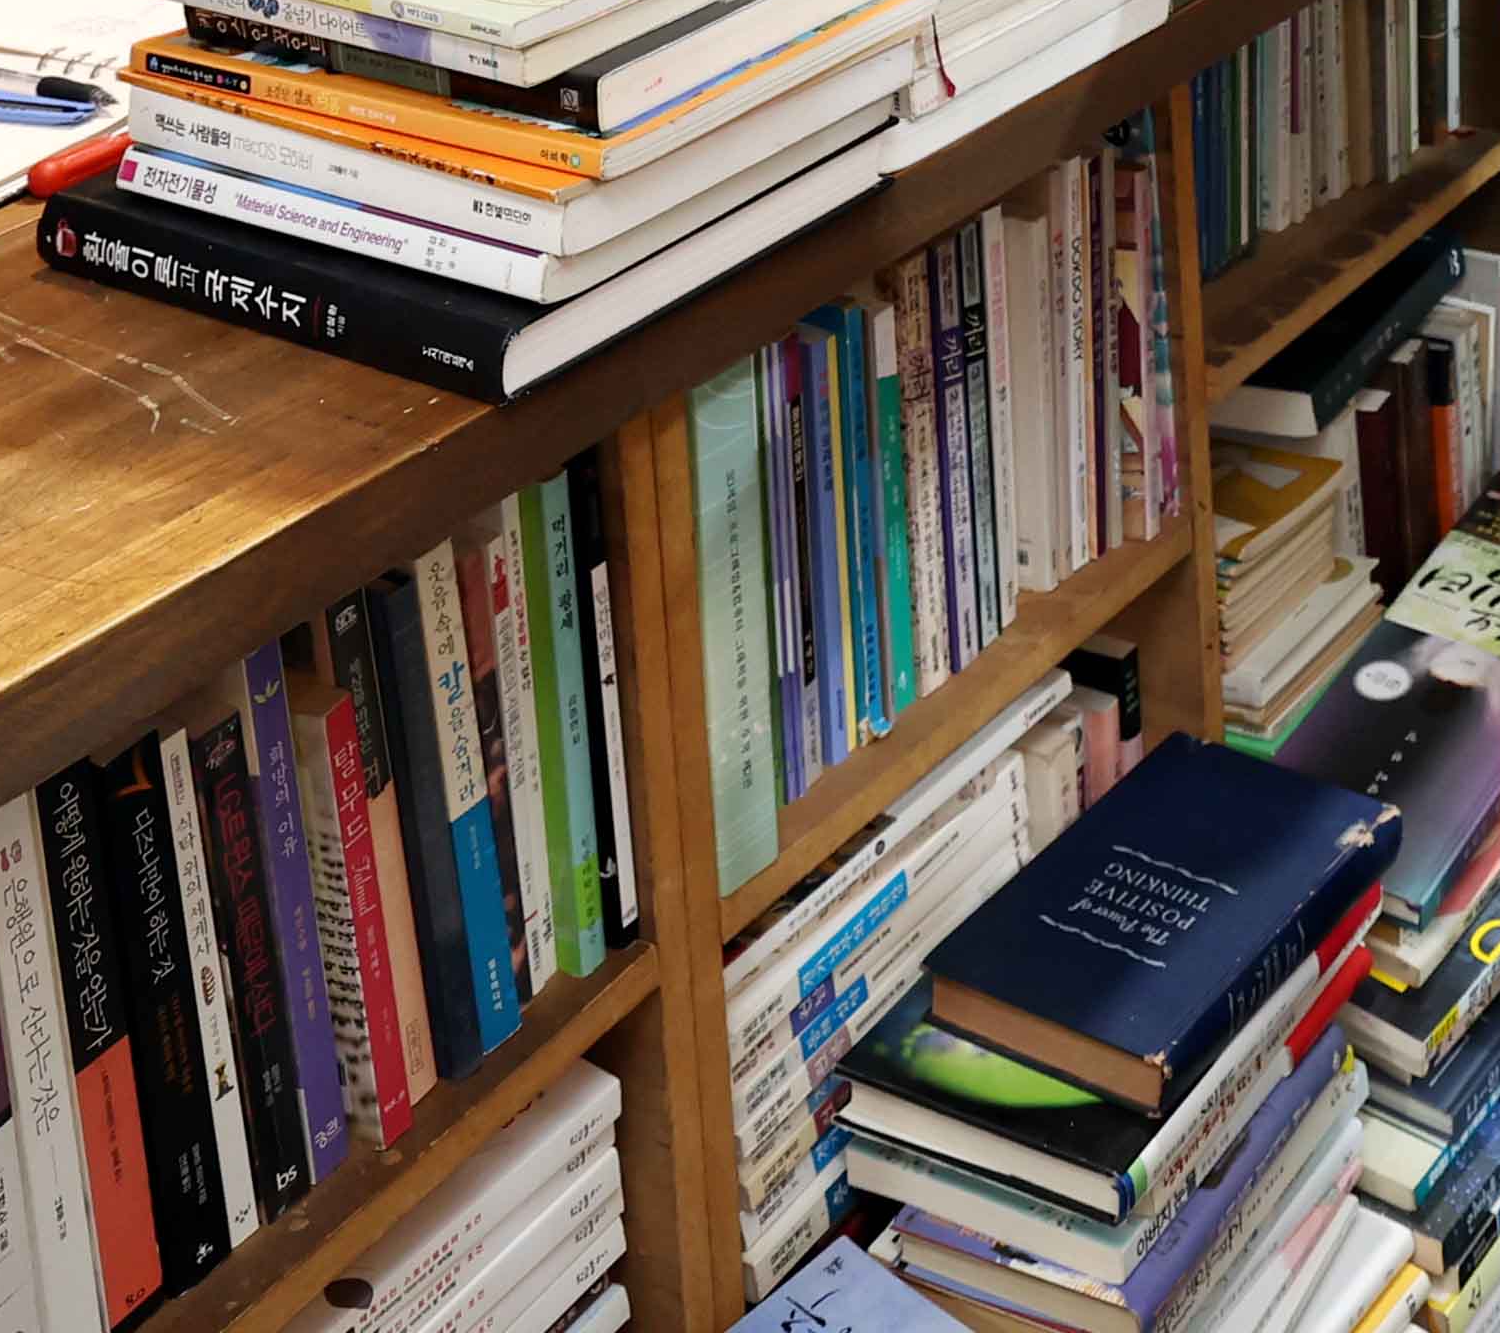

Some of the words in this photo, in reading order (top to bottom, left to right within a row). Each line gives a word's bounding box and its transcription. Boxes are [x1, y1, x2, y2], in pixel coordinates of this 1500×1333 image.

[142, 166, 218, 206] 전자전기물성
[276, 203, 317, 232] Science
[318, 217, 339, 236] and
[203, 269, 308, 328] 국제수지
[330, 740, 369, 850] 탈무드
[133, 806, 168, 912] 디즈니만이
[1084, 878, 1197, 931] POSITIVE
[1104, 861, 1211, 913] THINKING
[3, 877, 40, 1005] 은행원으로
[53, 780, 87, 859] 어떻게
[79, 971, 112, 1053] 얻는가
[148, 906, 172, 958] 하는
[1141, 923, 1169, 946] The
[153, 953, 176, 988] 것
